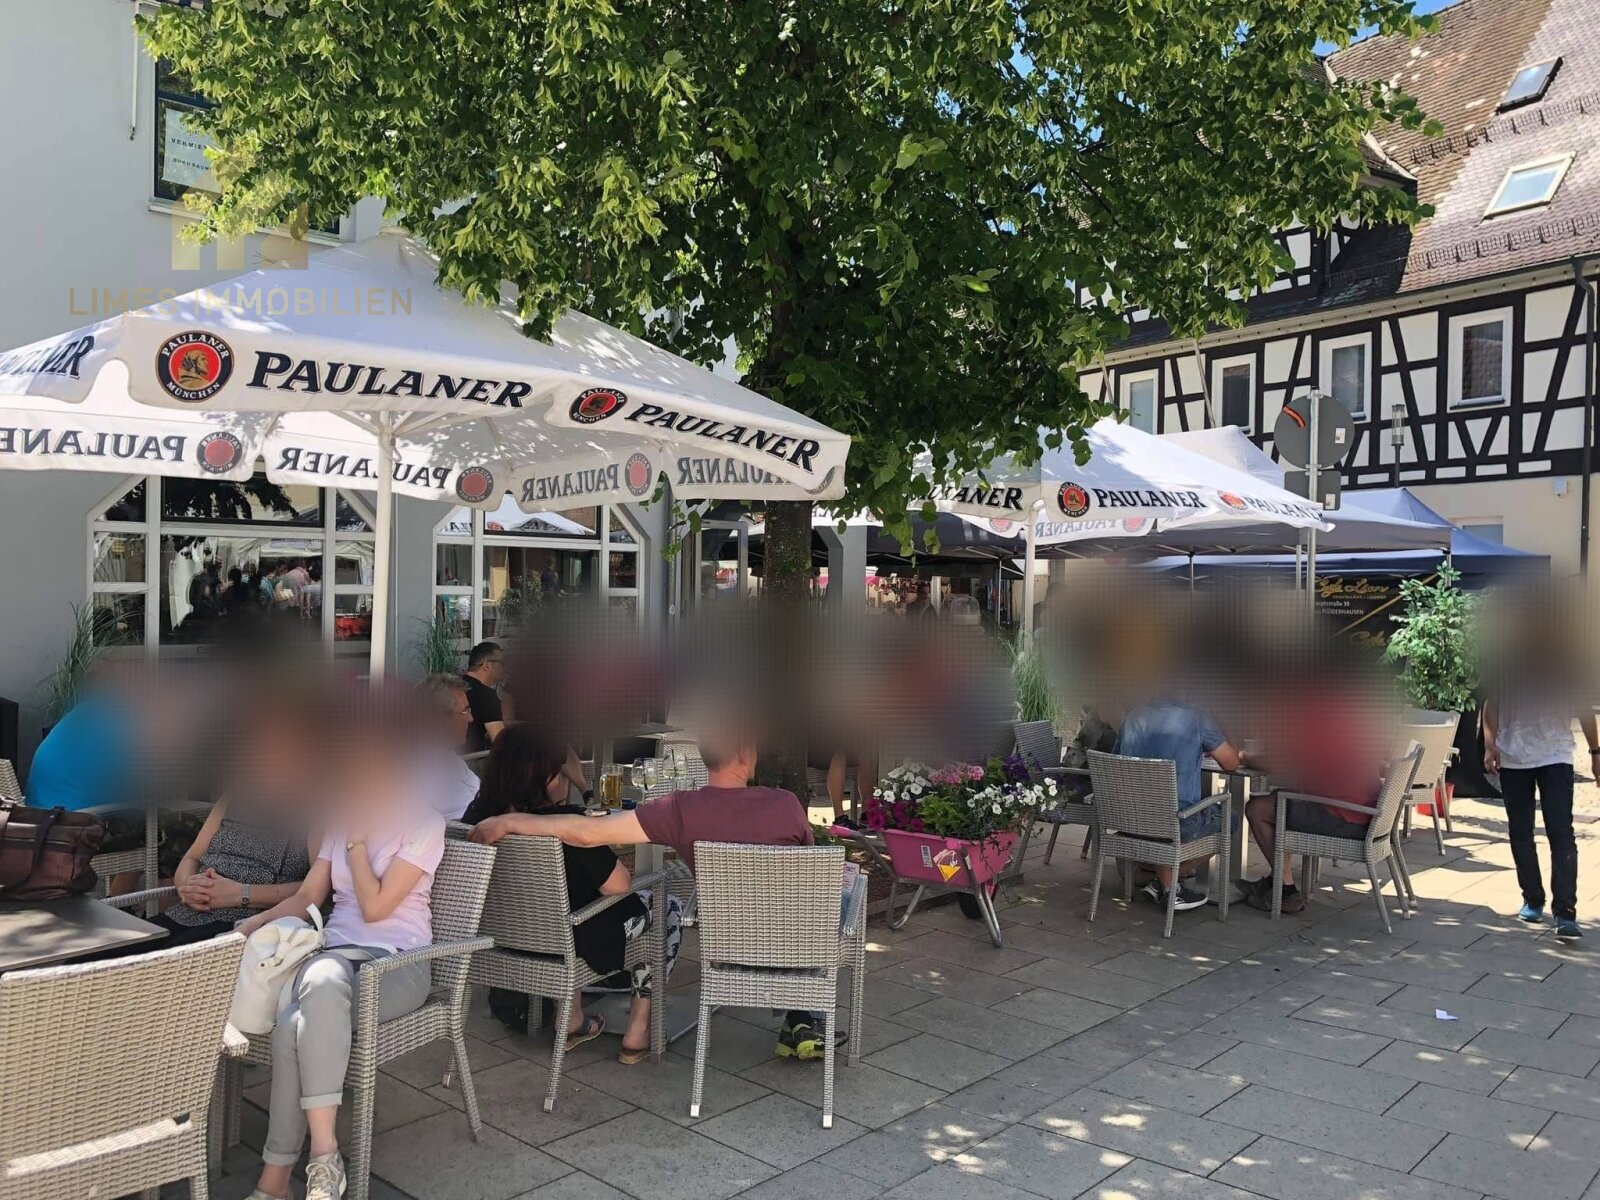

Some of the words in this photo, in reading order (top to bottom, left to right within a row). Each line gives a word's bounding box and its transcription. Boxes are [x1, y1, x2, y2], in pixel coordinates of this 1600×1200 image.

[162, 333, 230, 359] PAULANER
[246, 350, 533, 408] PAULANER
[624, 402, 821, 473] PAULANER
[1091, 488, 1207, 508] PAULANER
